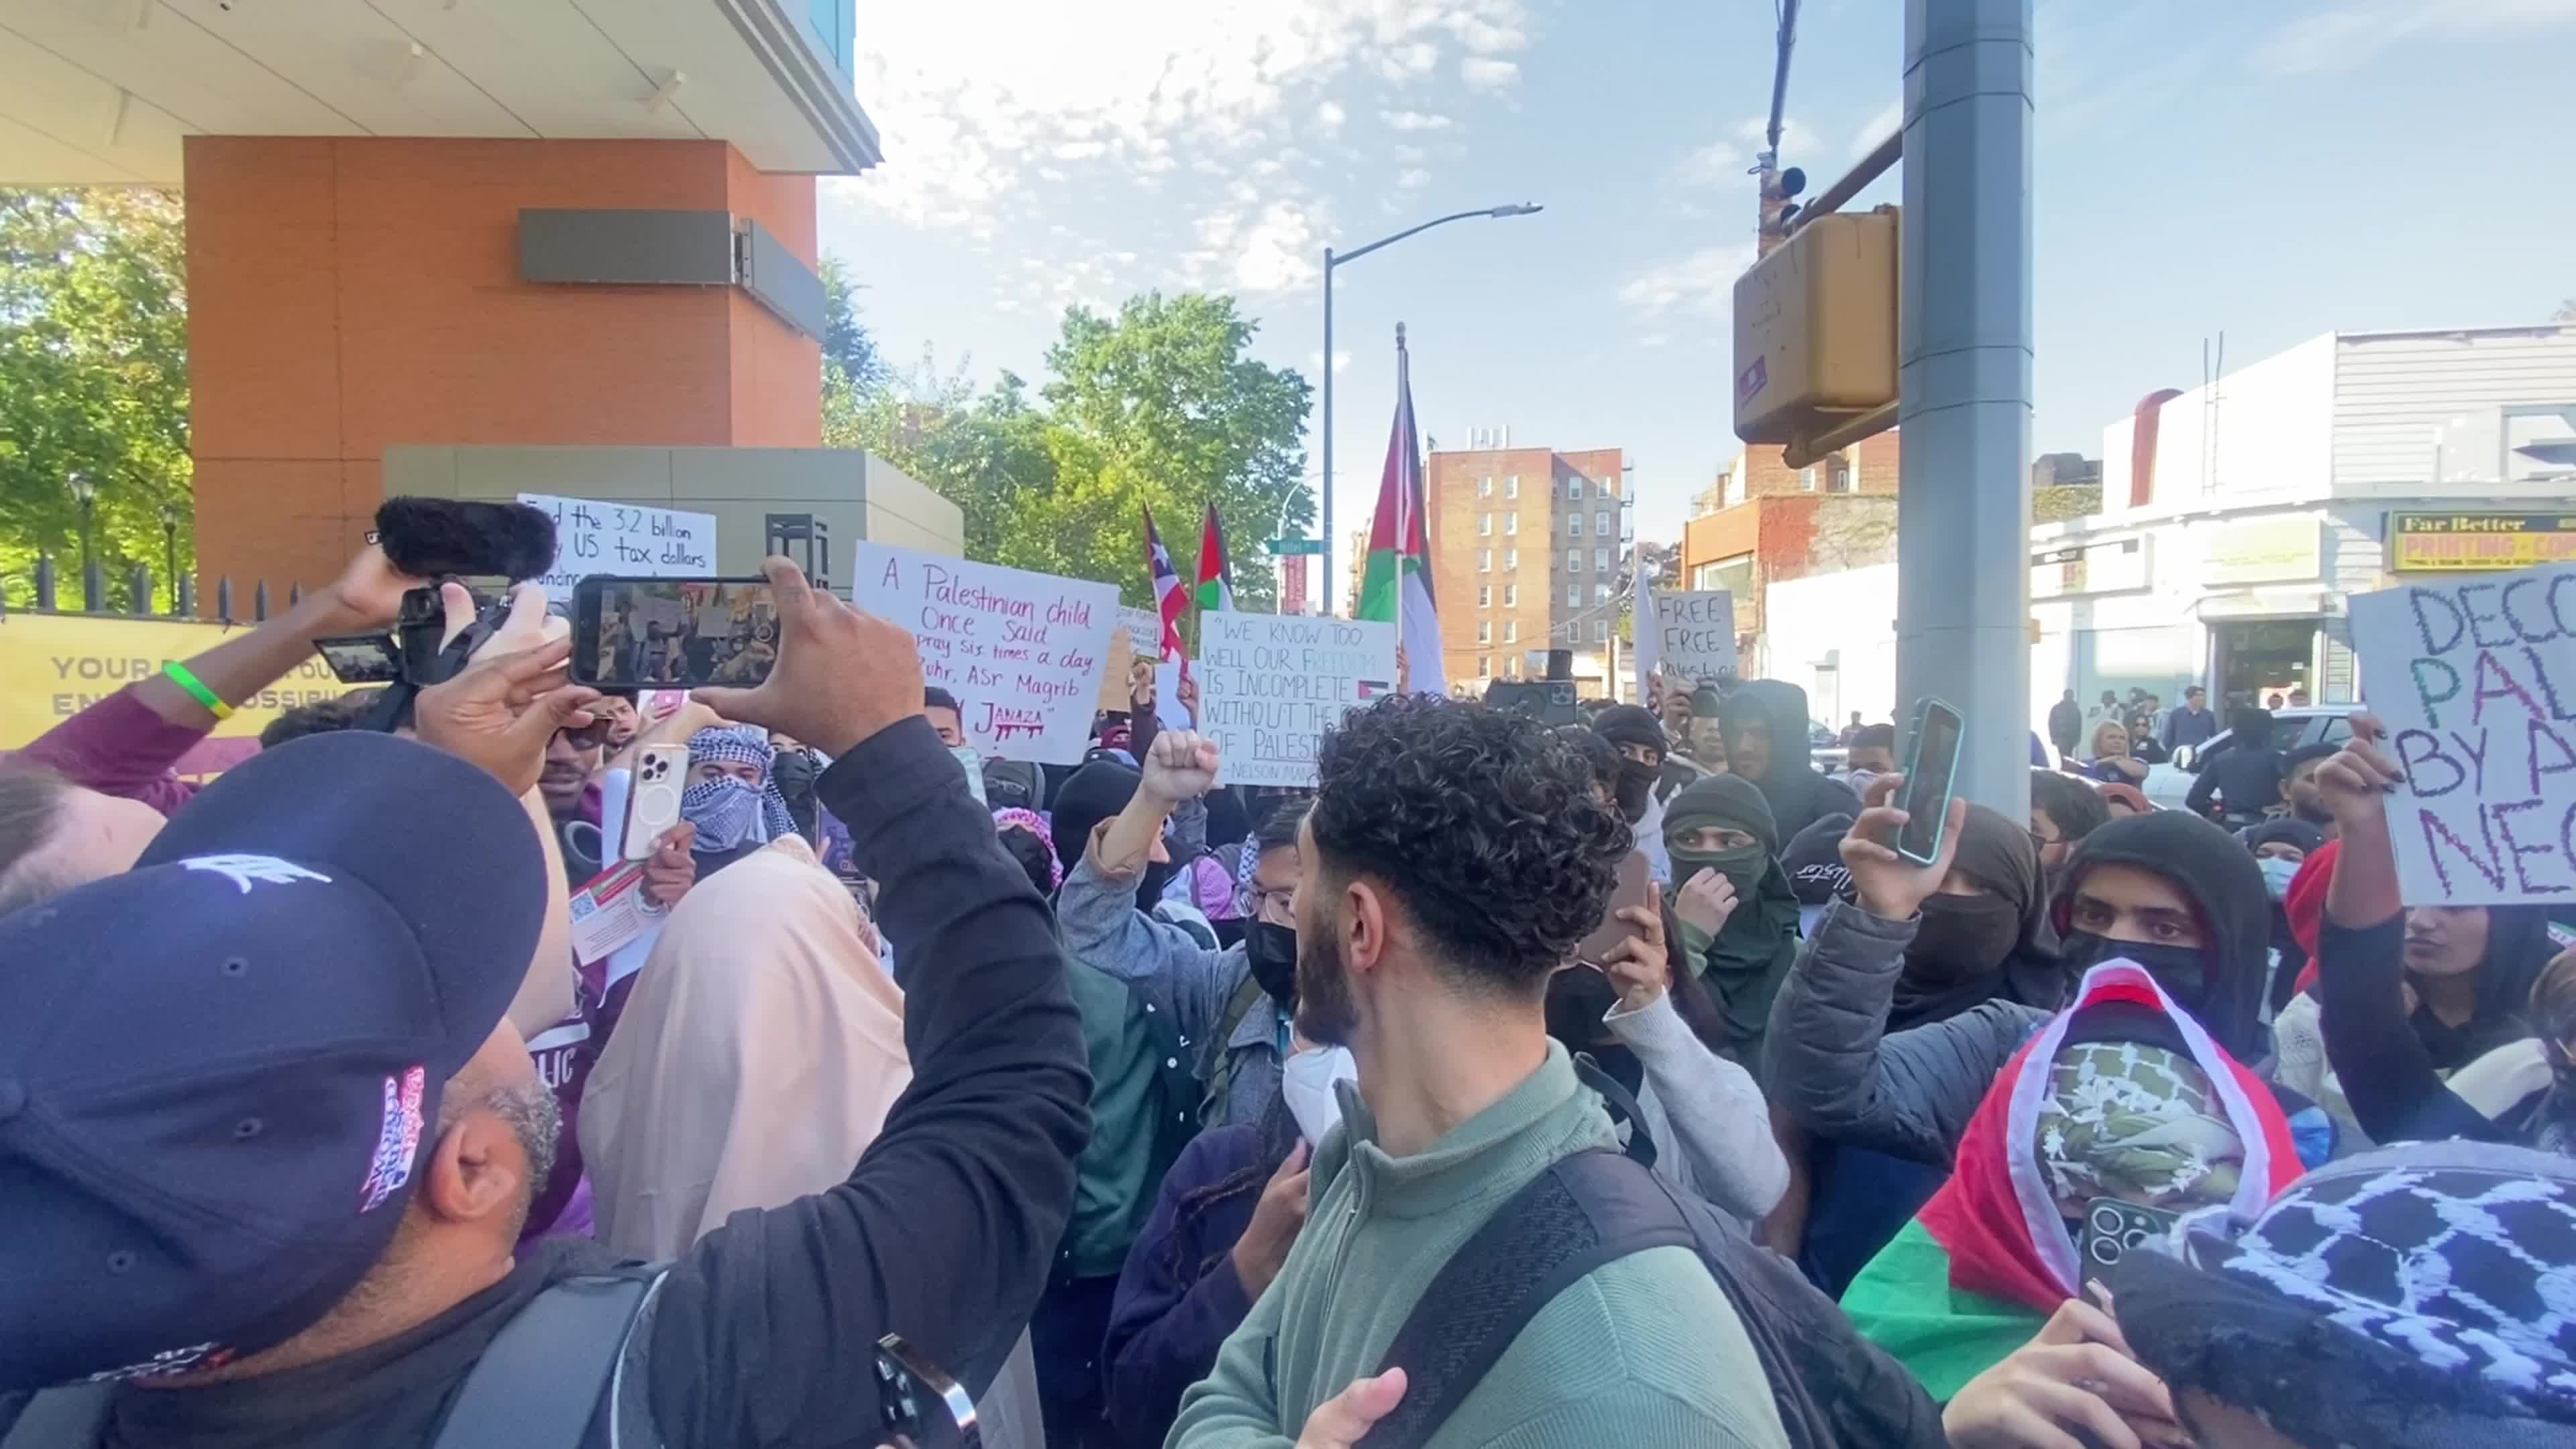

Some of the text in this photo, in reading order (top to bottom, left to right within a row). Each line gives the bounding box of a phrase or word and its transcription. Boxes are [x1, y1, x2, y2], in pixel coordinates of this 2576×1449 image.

[571, 504, 602, 531] the
[574, 533, 599, 558] US
[614, 536, 653, 564] tax
[661, 541, 706, 568] dollars
[2404, 534, 2514, 557] PRINTING
[882, 557, 899, 590] A
[922, 564, 1035, 621] Palestinian
[921, 606, 975, 636] Once
[1658, 596, 1721, 623] FREE
[1269, 622, 1322, 645] KNOW
[1328, 624, 1363, 647] TOO
[1664, 627, 1721, 653] FREE
[994, 644, 1029, 661] times
[1037, 652, 1051, 665] a
[1203, 645, 1376, 672] WELL OUR FREEDOM
[52, 657, 333, 680] YOUR OU
[1016, 674, 1079, 704] Magrib
[1204, 669, 1352, 702] IS INCOMPLETE
[1204, 698, 1299, 729] WITHOUT
[1304, 702, 1332, 731] THE
[1209, 729, 1237, 755] OF
[2396, 727, 2488, 798] BY
